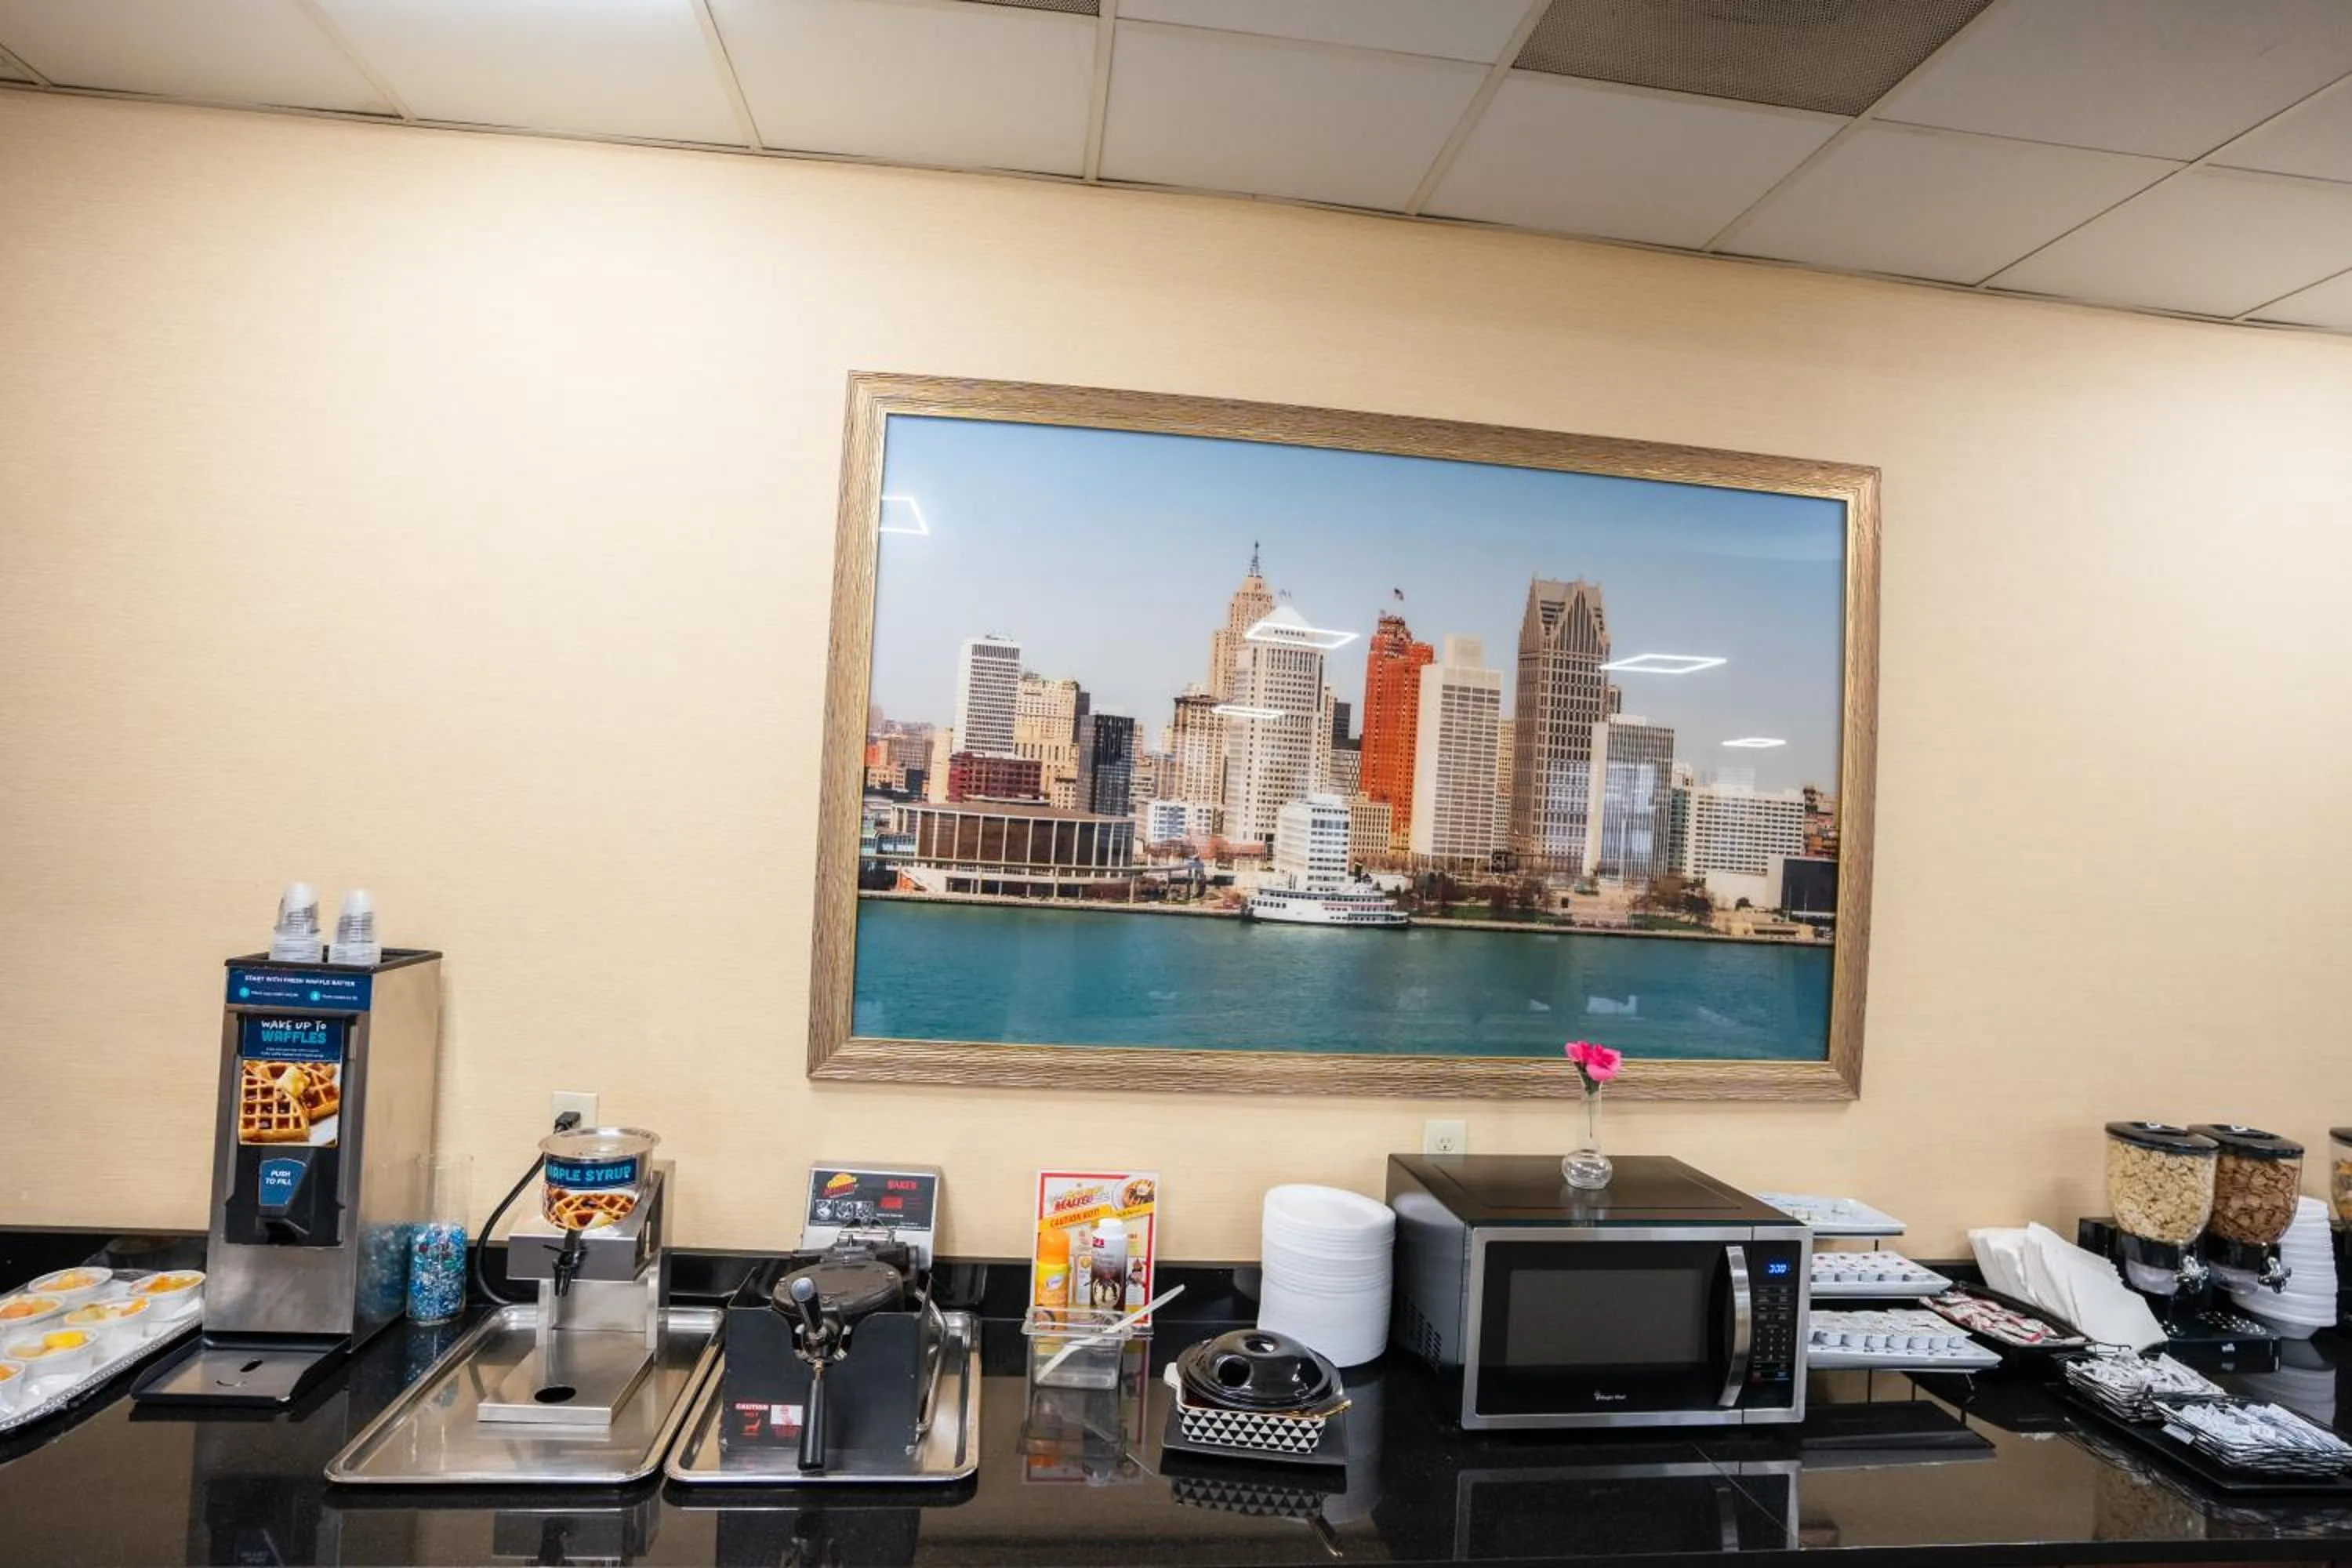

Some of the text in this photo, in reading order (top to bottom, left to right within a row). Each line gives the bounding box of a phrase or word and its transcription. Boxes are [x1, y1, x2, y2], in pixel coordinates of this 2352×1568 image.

[261, 1020, 292, 1030] WAKE
[295, 1021, 312, 1030] UP
[261, 1030, 327, 1044] WAFFLES
[585, 1166, 631, 1181] SYRUP
